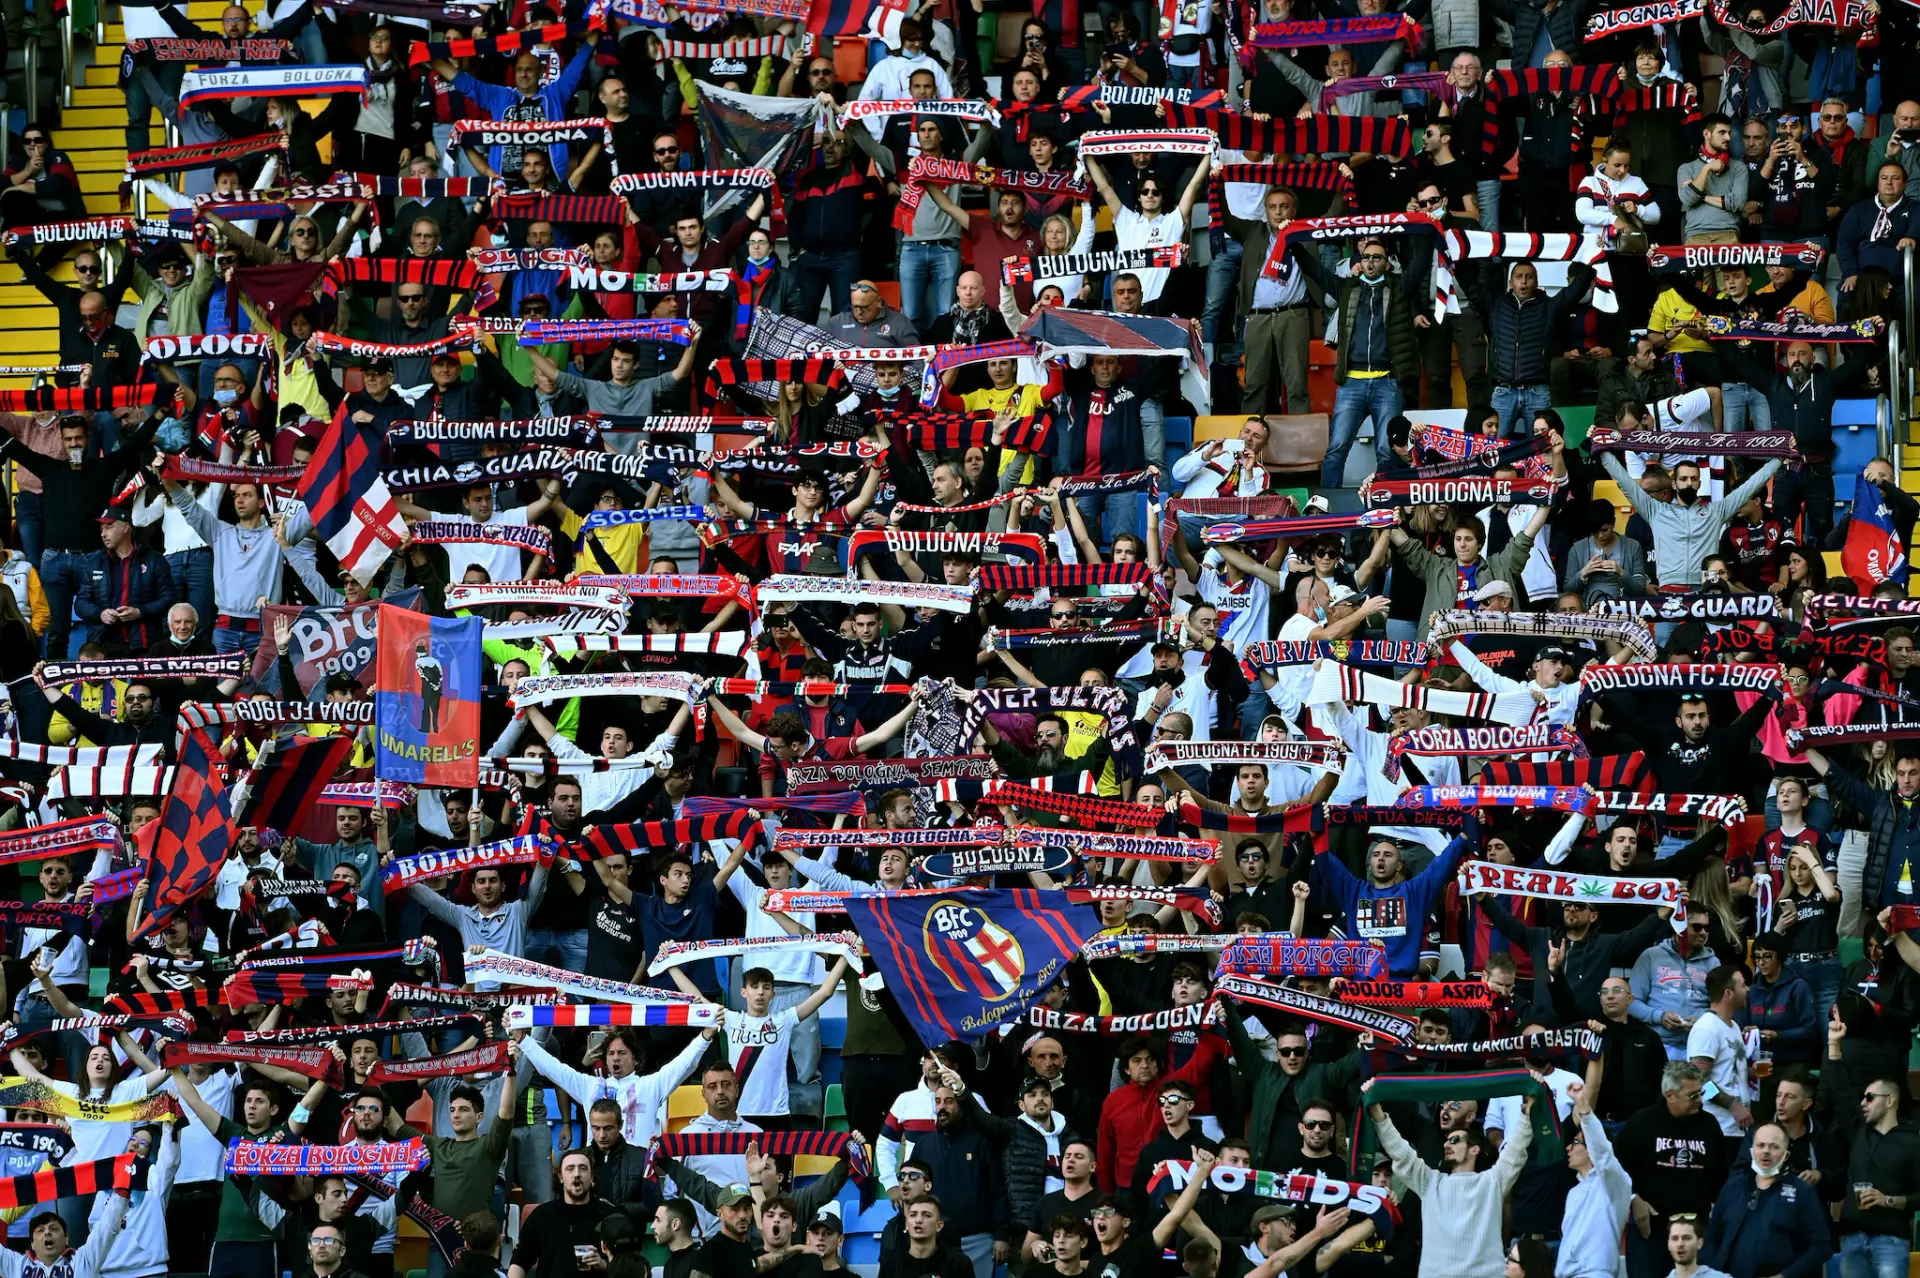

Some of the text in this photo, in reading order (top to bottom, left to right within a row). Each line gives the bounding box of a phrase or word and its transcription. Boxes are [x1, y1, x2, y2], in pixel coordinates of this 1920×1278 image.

[1594, 3, 1676, 32] OLOGNA
[151, 38, 225, 50] PRIMA
[155, 49, 242, 61] SEMPRE
[199, 68, 354, 87] FORZA BOLOGNA
[1101, 85, 1192, 106] BOLOGNA FC
[851, 100, 987, 117] CONTROTENDENZA
[482, 128, 589, 145] BOLOGNA
[1082, 143, 1207, 154] BOLOGNA 1974
[612, 170, 697, 195] BOLOGNA
[701, 171, 725, 187] FC
[1001, 168, 1088, 193] 1974
[1306, 212, 1409, 228] VECCHIA
[33, 218, 125, 244] BOLOGNA FC
[171, 228, 194, 240] TEN
[1311, 224, 1405, 239] GUARDIA
[1038, 251, 1129, 279] BOLOGNA
[1130, 259, 1147, 269] 1909
[1685, 245, 1784, 267] BOLOGNA FC
[1271, 260, 1288, 274] 1974
[540, 321, 673, 343] BOLOGNA
[414, 416, 572, 440] BOLOGNA FC 1909
[1627, 430, 1792, 450] Bologna 1909
[574, 449, 650, 479] ARE ONE
[1058, 475, 1096, 494] ologna
[1410, 480, 1512, 505] BOLOGNA FC
[591, 504, 697, 528] SOCMEL
[885, 530, 1001, 554] BOLOGNA FC
[983, 544, 1000, 554] 1909
[658, 576, 720, 592] ULTRAS
[295, 605, 380, 661] BFC
[1026, 634, 1068, 648] Sempre
[1081, 631, 1141, 646] Comunque
[315, 646, 373, 677] 1909
[1251, 638, 1430, 666] CURVA NORD
[43, 662, 123, 679] Bologna
[170, 658, 241, 673] Magic
[1587, 664, 1777, 693] BOLOGNA FC 1909
[236, 701, 286, 721] 1909
[1412, 723, 1549, 751] FORZA BOLOGNA
[1176, 743, 1300, 760] BOLOGNA FC 1909
[921, 759, 991, 778] SEMPRE
[1432, 783, 1547, 800] FORZA BOLOGNA
[1354, 811, 1464, 827] IN TUA DIFESA
[1597, 790, 1746, 828] ALLA FINE
[809, 830, 971, 845] FORZA BOLOGNA
[1115, 837, 1186, 856] BOLOGNA
[397, 834, 535, 880] BOLOGNA
[952, 846, 1046, 868] BOLOGNA
[1089, 887, 1178, 904] BOLOGNA
[32, 900, 91, 917] ONORE
[15, 912, 63, 927] DIFESA
[933, 906, 973, 934] BFC
[947, 928, 969, 941] 1909
[484, 954, 575, 987] FOREVER
[1245, 981, 1319, 1011] BAYERN
[1110, 1002, 1217, 1033] BOLOGNA
[1530, 1032, 1541, 1050] A
[1545, 1028, 1603, 1054] BASTONI
[234, 1144, 412, 1167] FORZA BOLOGNA
